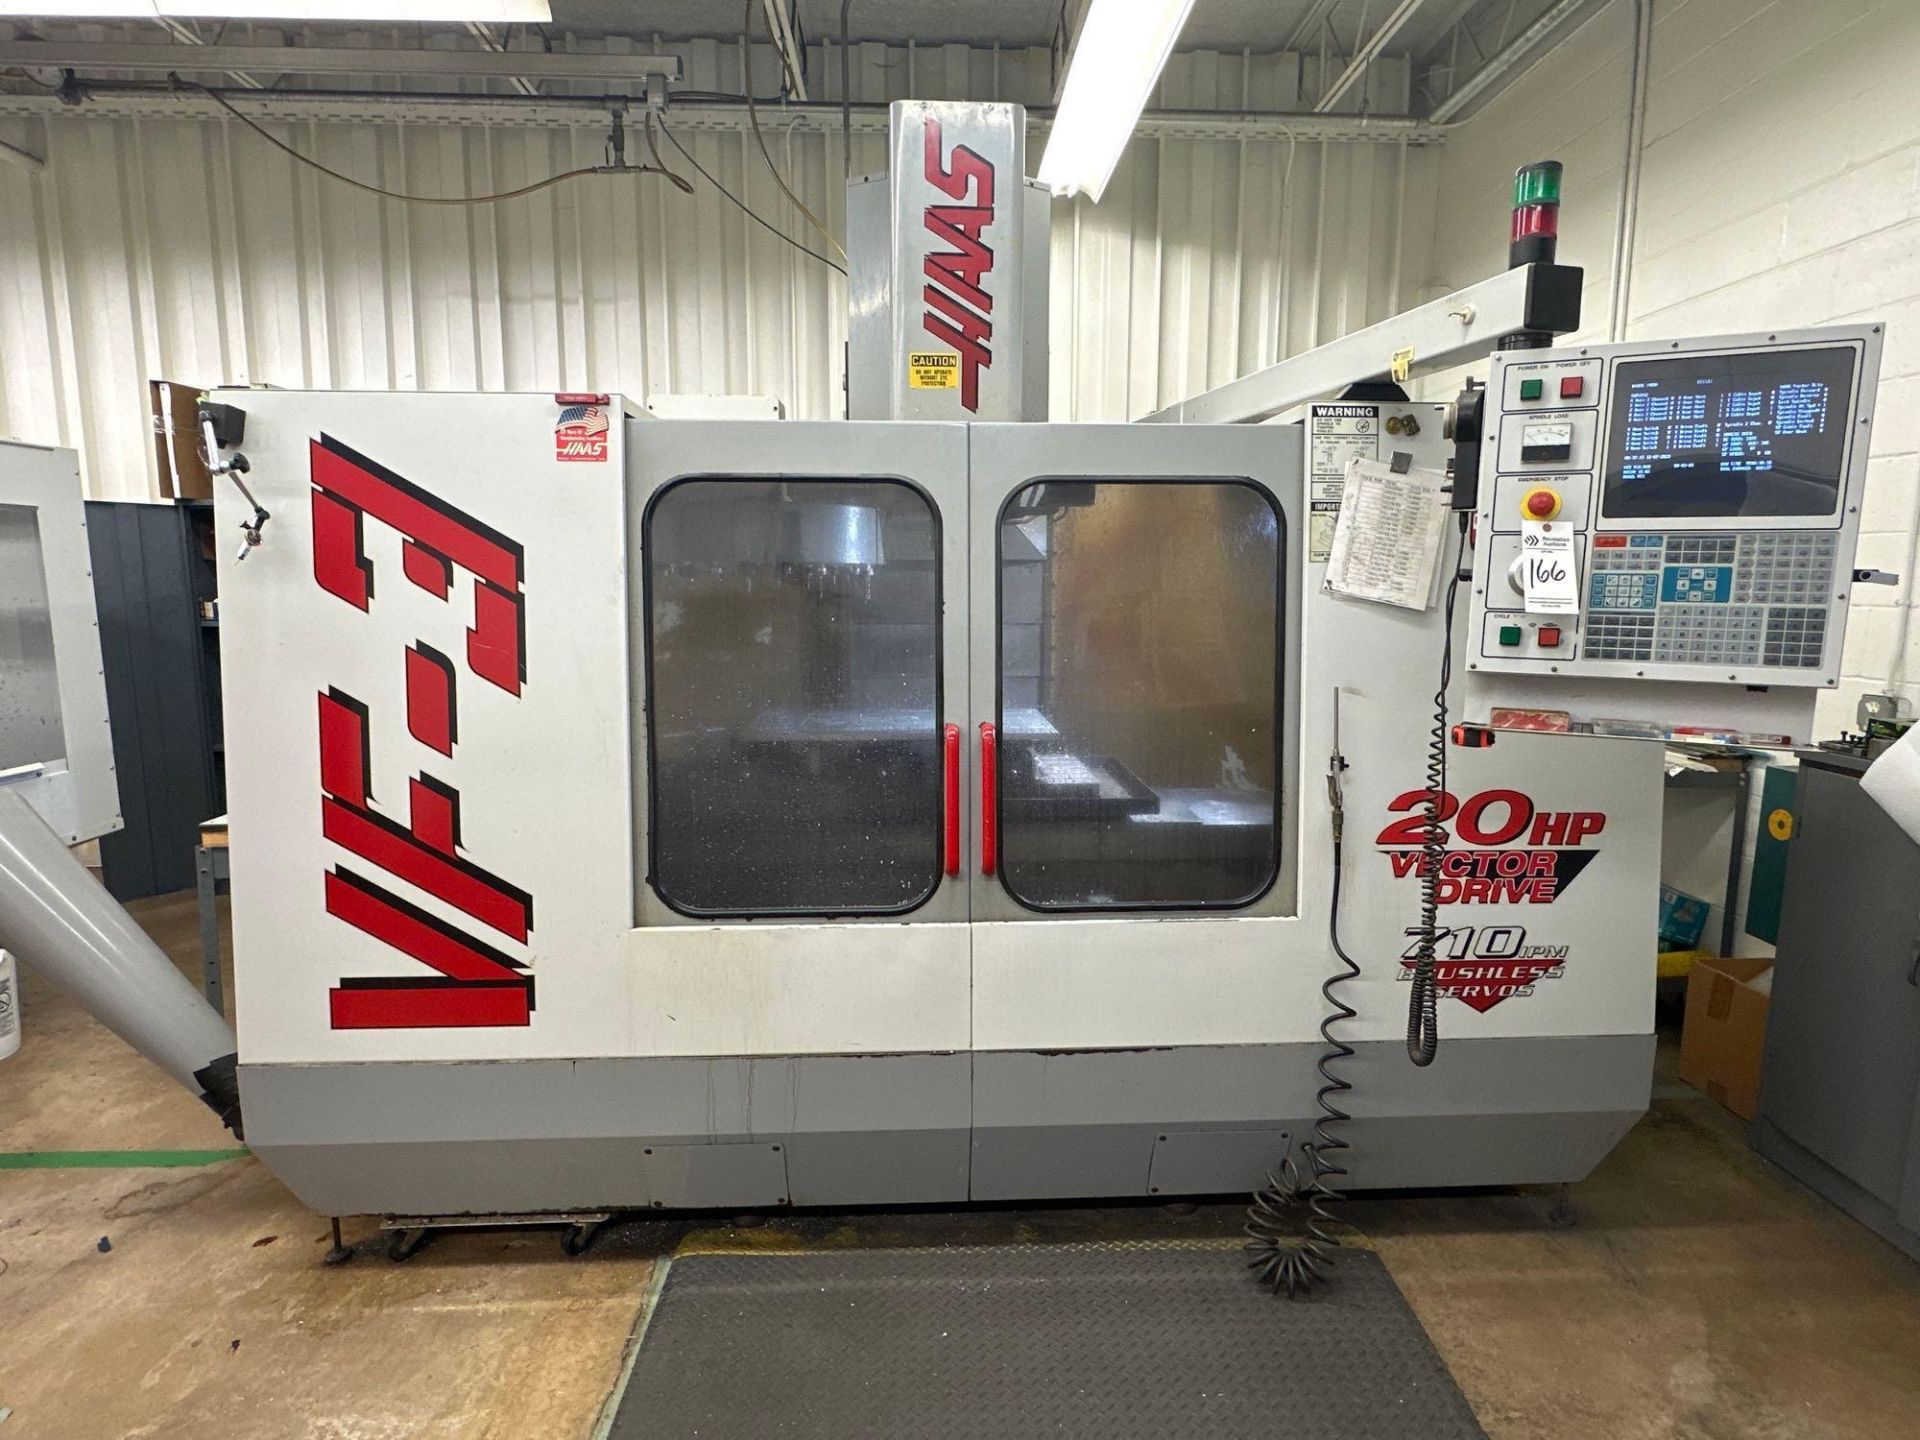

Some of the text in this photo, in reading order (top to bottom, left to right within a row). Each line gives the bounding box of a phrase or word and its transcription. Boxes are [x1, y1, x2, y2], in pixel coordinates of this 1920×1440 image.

[923, 115, 995, 414] HAAS
[912, 356, 956, 366] CAUTION
[1316, 407, 1374, 417] WARNING
[556, 442, 608, 456] HAAS
[1314, 502, 1339, 510] IMPORT
[1530, 558, 1566, 589] 166
[1434, 878, 1558, 904] DRIVE
[1396, 966, 1566, 981] BUSHLESS
[1435, 984, 1536, 999] SERVOS
